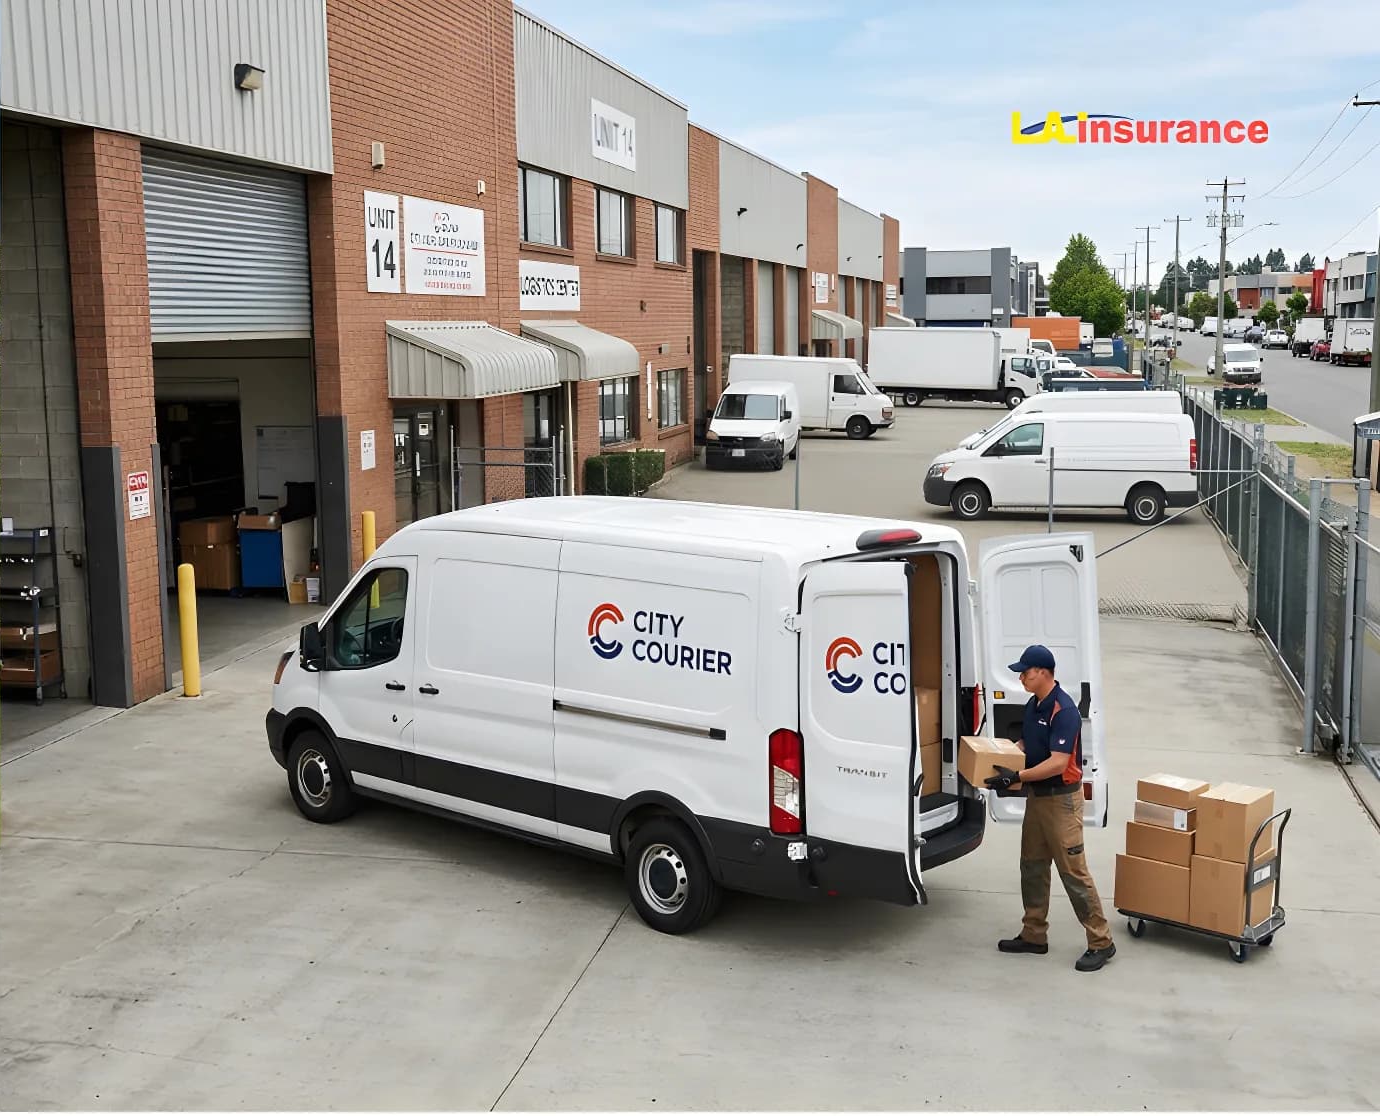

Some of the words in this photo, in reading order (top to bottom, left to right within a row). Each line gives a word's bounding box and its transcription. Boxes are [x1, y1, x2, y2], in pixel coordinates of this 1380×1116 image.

[368, 206, 396, 230] UNIT
[372, 238, 396, 279] 14
[633, 610, 684, 638] CITY
[632, 639, 732, 676] COURIER
